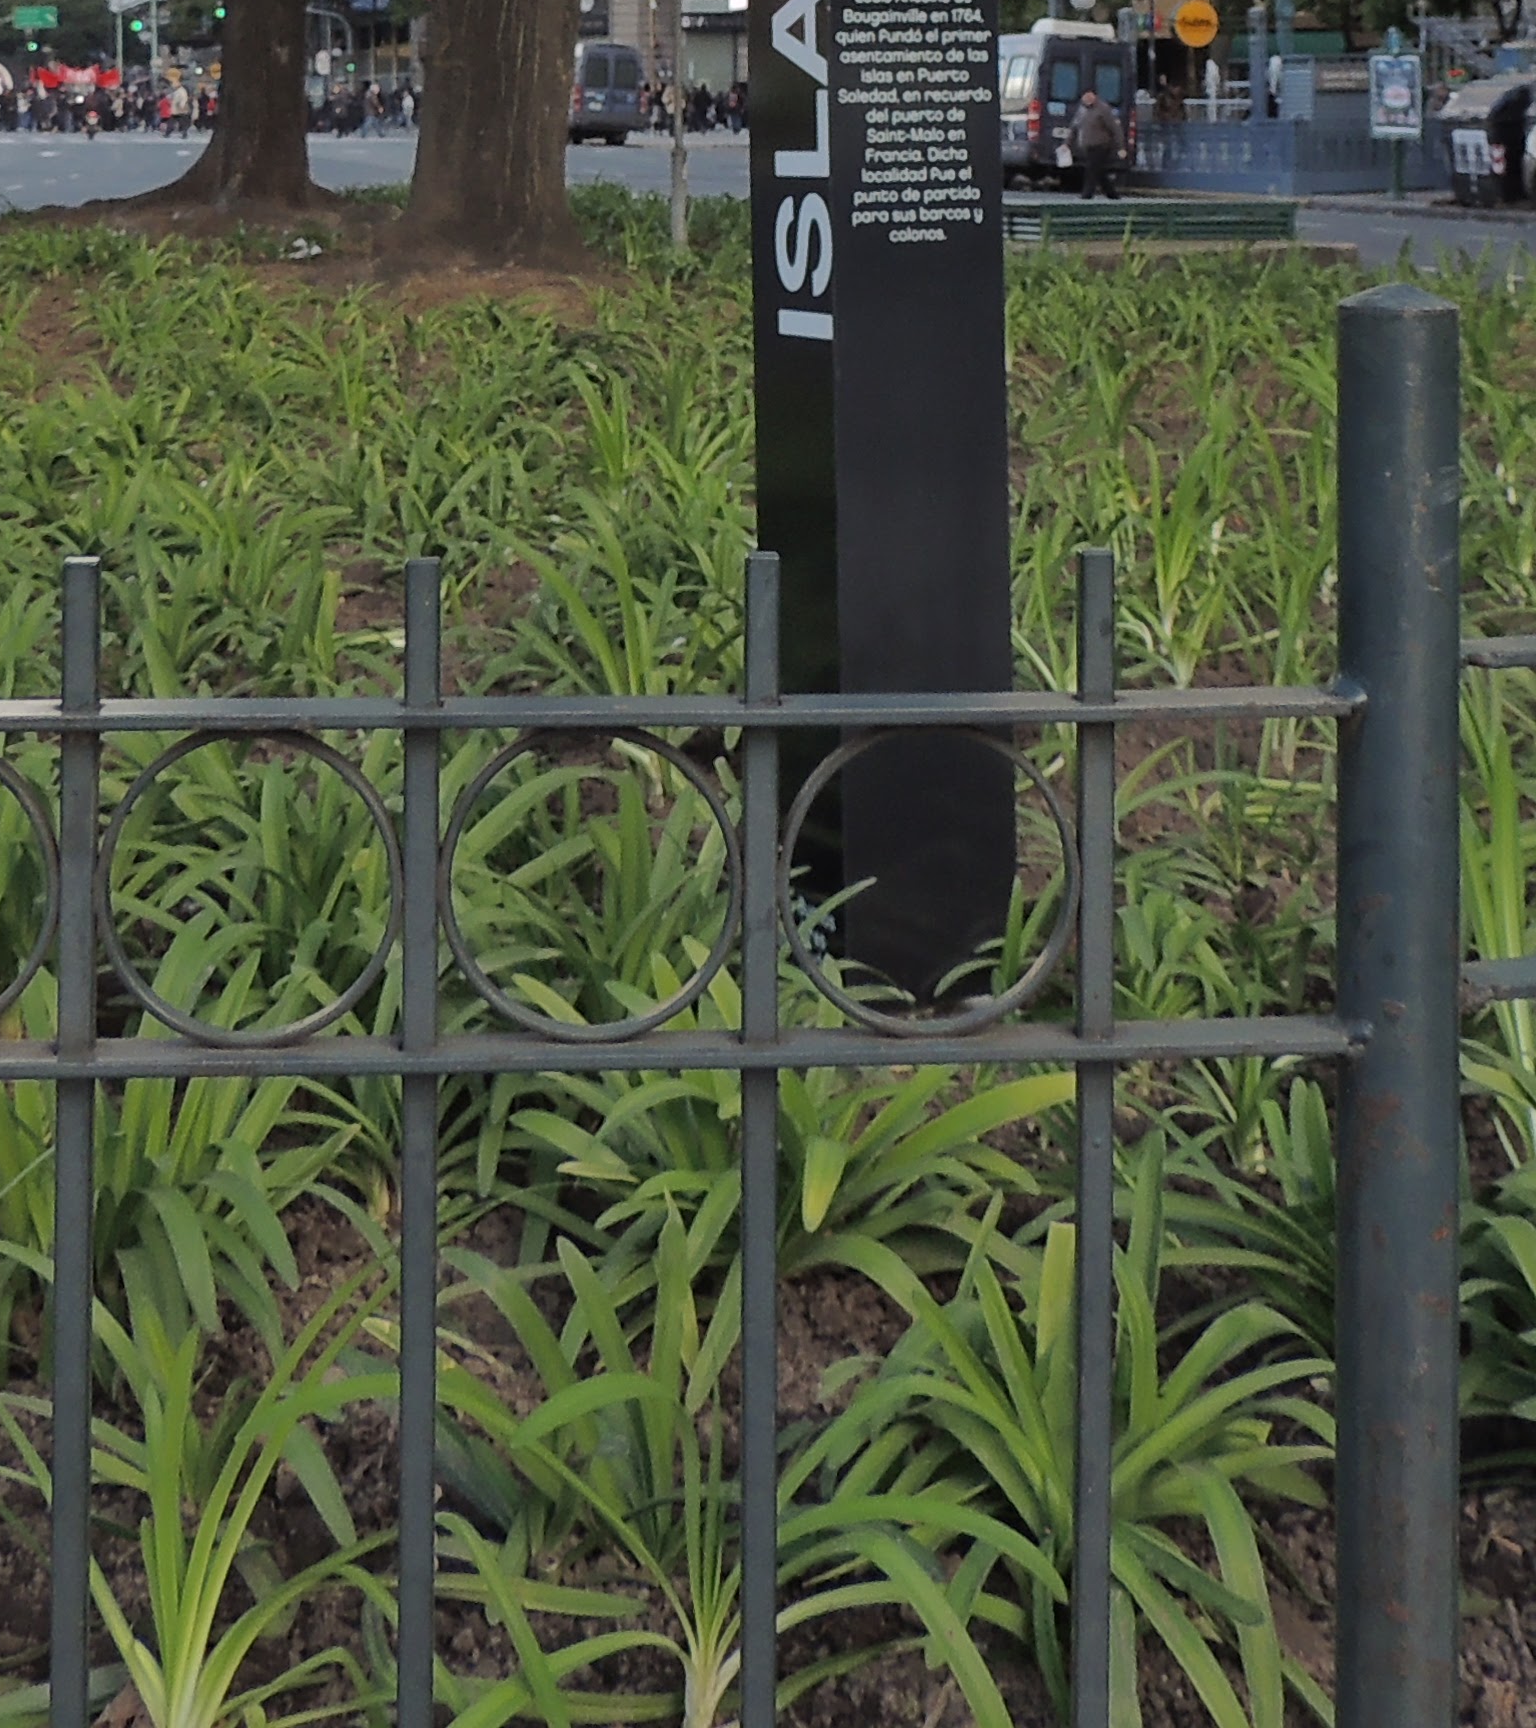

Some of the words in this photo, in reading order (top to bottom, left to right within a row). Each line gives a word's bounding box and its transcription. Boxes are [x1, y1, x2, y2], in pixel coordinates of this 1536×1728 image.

[843, 8, 928, 27] Bougainville
[930, 10, 949, 22] en
[835, 29, 875, 46] quien
[925, 28, 939, 42] el
[941, 29, 992, 45] primer
[839, 49, 943, 64] asentamiento
[945, 48, 964, 63] de
[967, 48, 989, 63] las
[896, 71, 914, 83] en
[917, 68, 970, 83] Puerto
[902, 90, 921, 102] en
[924, 87, 992, 102] recuerdo
[865, 108, 889, 123] del
[891, 110, 944, 125] puerto
[946, 107, 966, 122] de
[866, 127, 945, 143] Saint-Malo
[947, 129, 966, 142] en
[927, 146, 968, 162] Dicha
[861, 166, 927, 183] localidad
[958, 166, 972, 180] el
[853, 190, 898, 207] punto
[901, 187, 920, 202] de
[851, 210, 889, 227] para
[892, 209, 916, 223] sus
[919, 206, 971, 221] barcos
[973, 208, 983, 223] y
